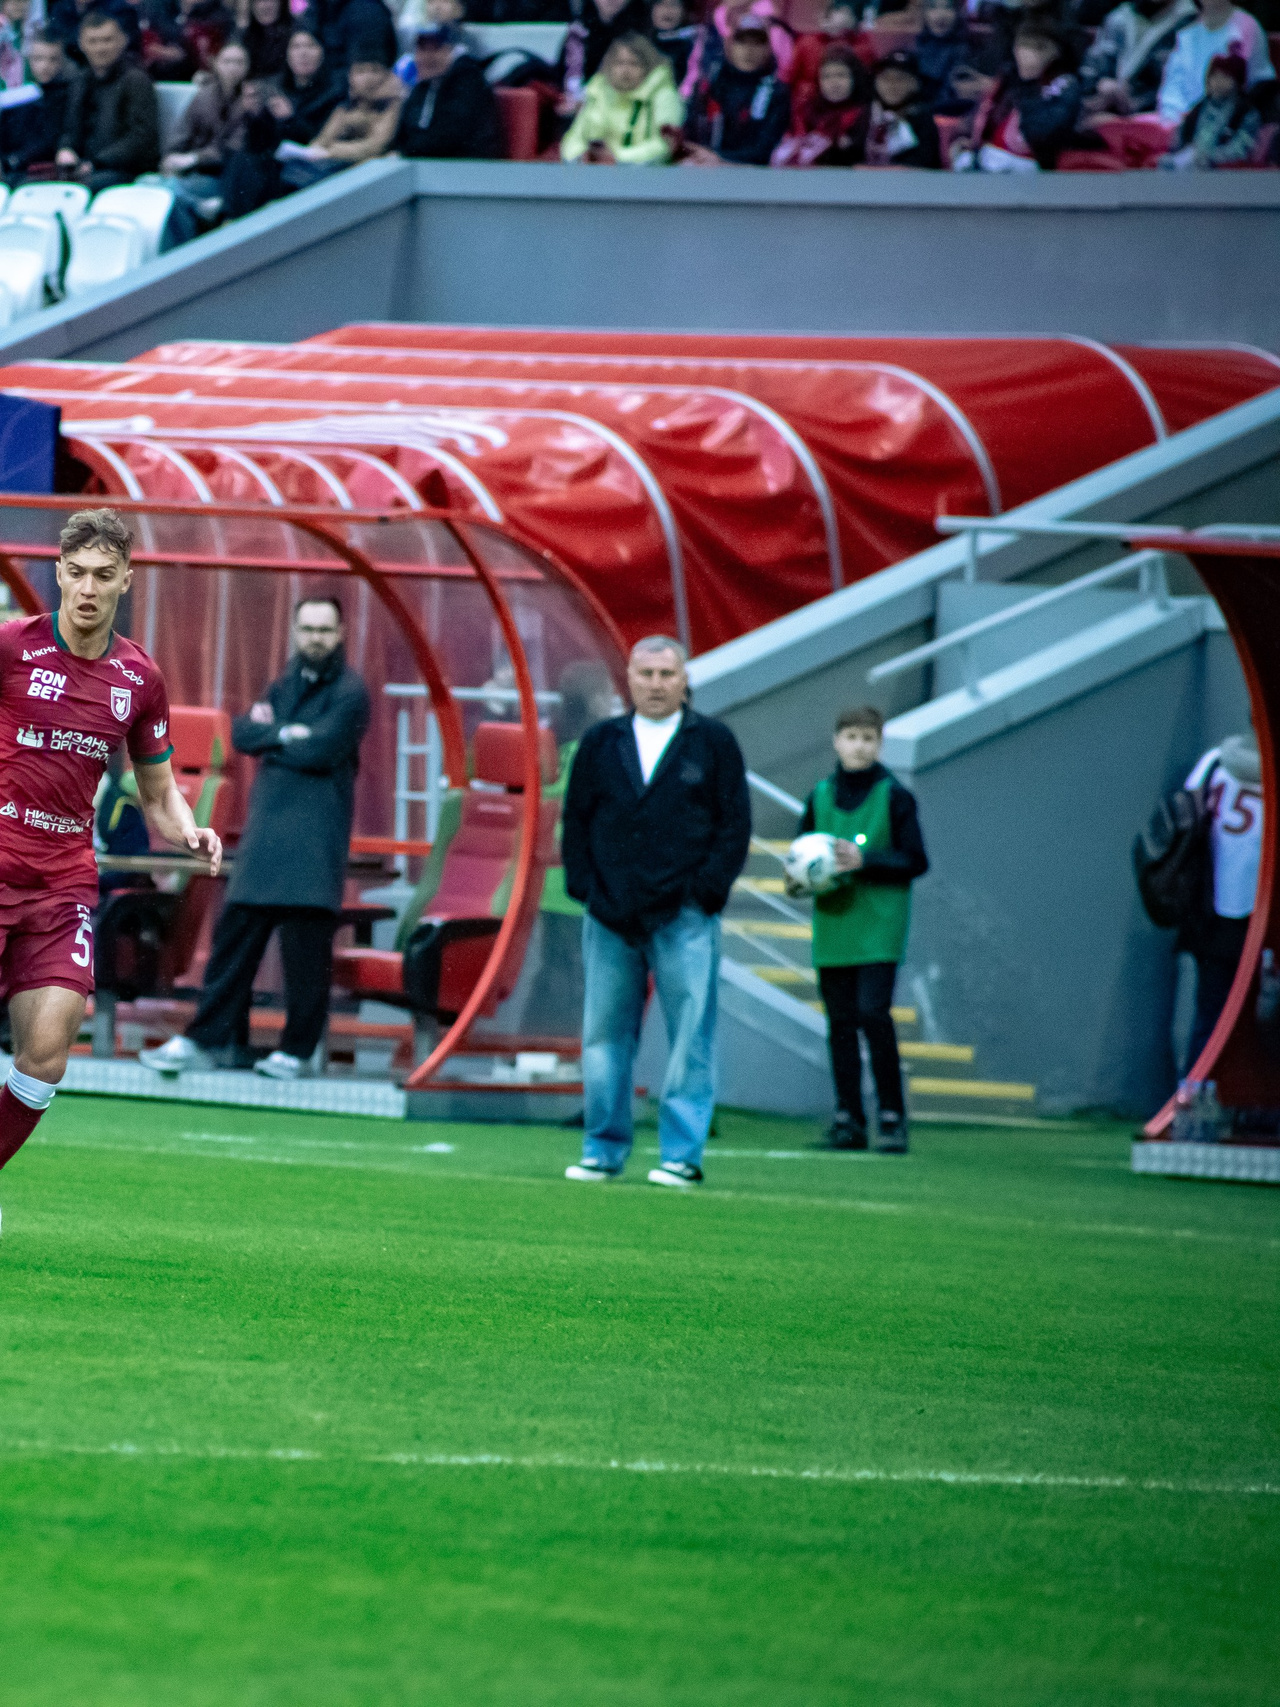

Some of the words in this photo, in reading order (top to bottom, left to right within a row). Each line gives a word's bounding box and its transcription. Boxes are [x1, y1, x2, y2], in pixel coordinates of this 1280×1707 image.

[29, 667, 67, 688] FON
[27, 682, 66, 702] BET
[52, 729, 109, 751] КАЗАНЬ
